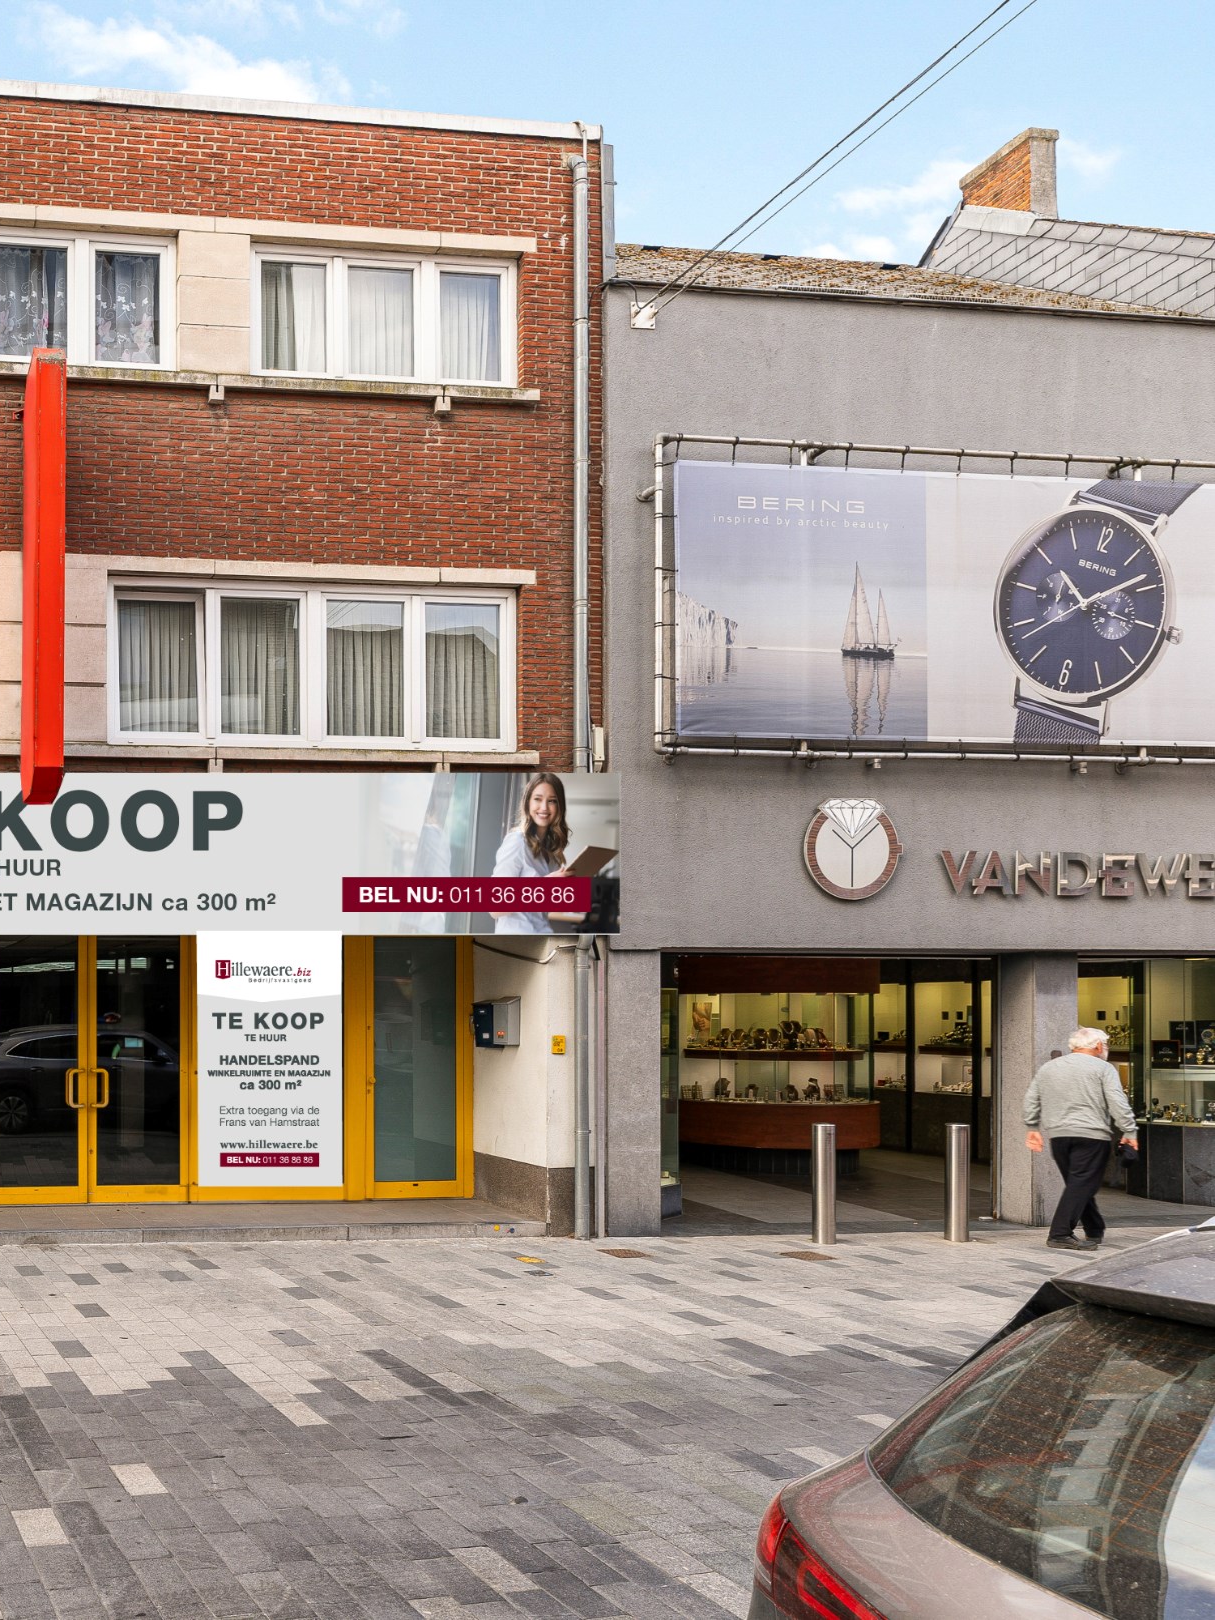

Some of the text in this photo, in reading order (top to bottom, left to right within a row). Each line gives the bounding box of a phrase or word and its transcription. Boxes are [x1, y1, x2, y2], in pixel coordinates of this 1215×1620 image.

[737, 495, 865, 514] BERING
[712, 513, 889, 531] inspired by arctic beauty
[1096, 526, 1114, 553] 12
[1078, 558, 1118, 577] BERING
[1059, 659, 1073, 686] 6
[26, 892, 153, 912] MAGAZIJN
[161, 896, 188, 912] ca
[197, 892, 238, 912] 300
[359, 886, 576, 904] BEL NU: 011 36 86 86
[211, 1012, 325, 1031] TE KOOP
[244, 1033, 287, 1042] TE HUUR
[219, 1054, 321, 1066] HANDELSPAND
[207, 1069, 331, 1078] WINKELRUIMTE EN MAGAZIJN
[239, 1081, 255, 1090] ca
[258, 1079, 281, 1091] 300
[219, 1105, 320, 1117] Extra toegang via de
[219, 1117, 320, 1127] Frans van Hamstraat
[220, 1139, 319, 1149] www.hillewaere.be
[226, 1156, 244, 1164] BEL
[245, 1156, 261, 1164] NU:
[262, 1156, 277, 1164] 011
